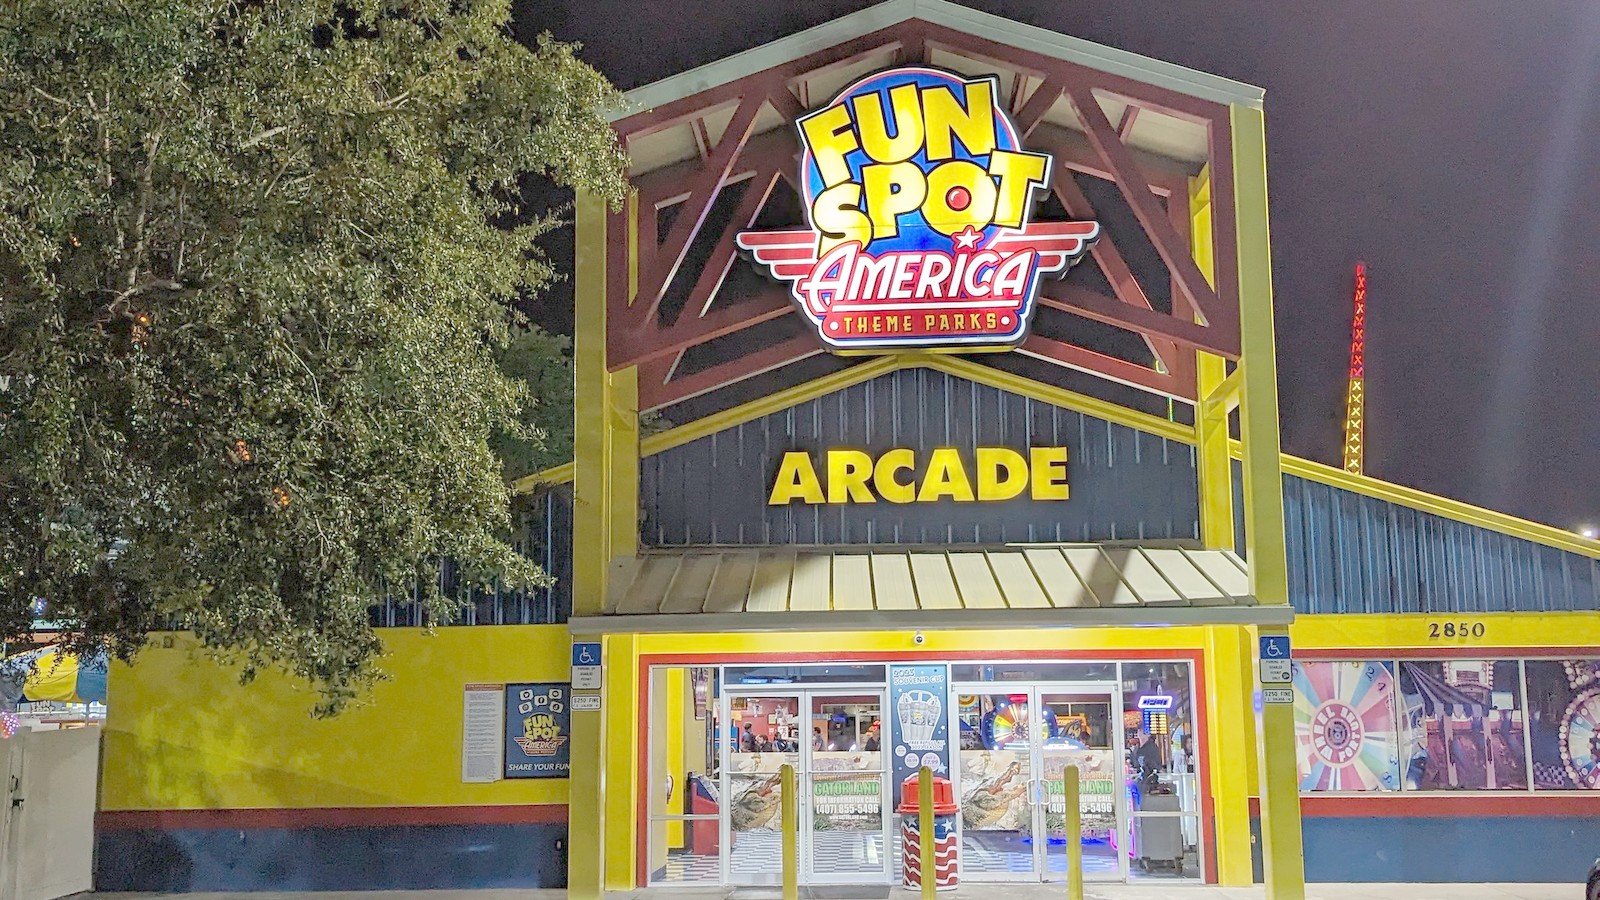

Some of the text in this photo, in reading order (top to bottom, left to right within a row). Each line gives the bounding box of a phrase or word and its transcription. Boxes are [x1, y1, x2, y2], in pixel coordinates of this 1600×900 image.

[802, 81, 996, 186] FUN
[812, 150, 1047, 259] SPOT
[801, 242, 1036, 301] AMERICA
[844, 313, 997, 333] THEME PARKS
[768, 446, 1070, 505] ARCADE
[1428, 622, 1485, 638] 2850
[893, 674, 945, 685] SOUVENIR CUP
[523, 713, 554, 731] FUN
[524, 740, 558, 749] AMERICA
[508, 763, 533, 771] SHARE
[534, 763, 555, 771] YOUR
[814, 782, 880, 796] GATORLAND
[816, 803, 879, 815] (407) 855-5496
